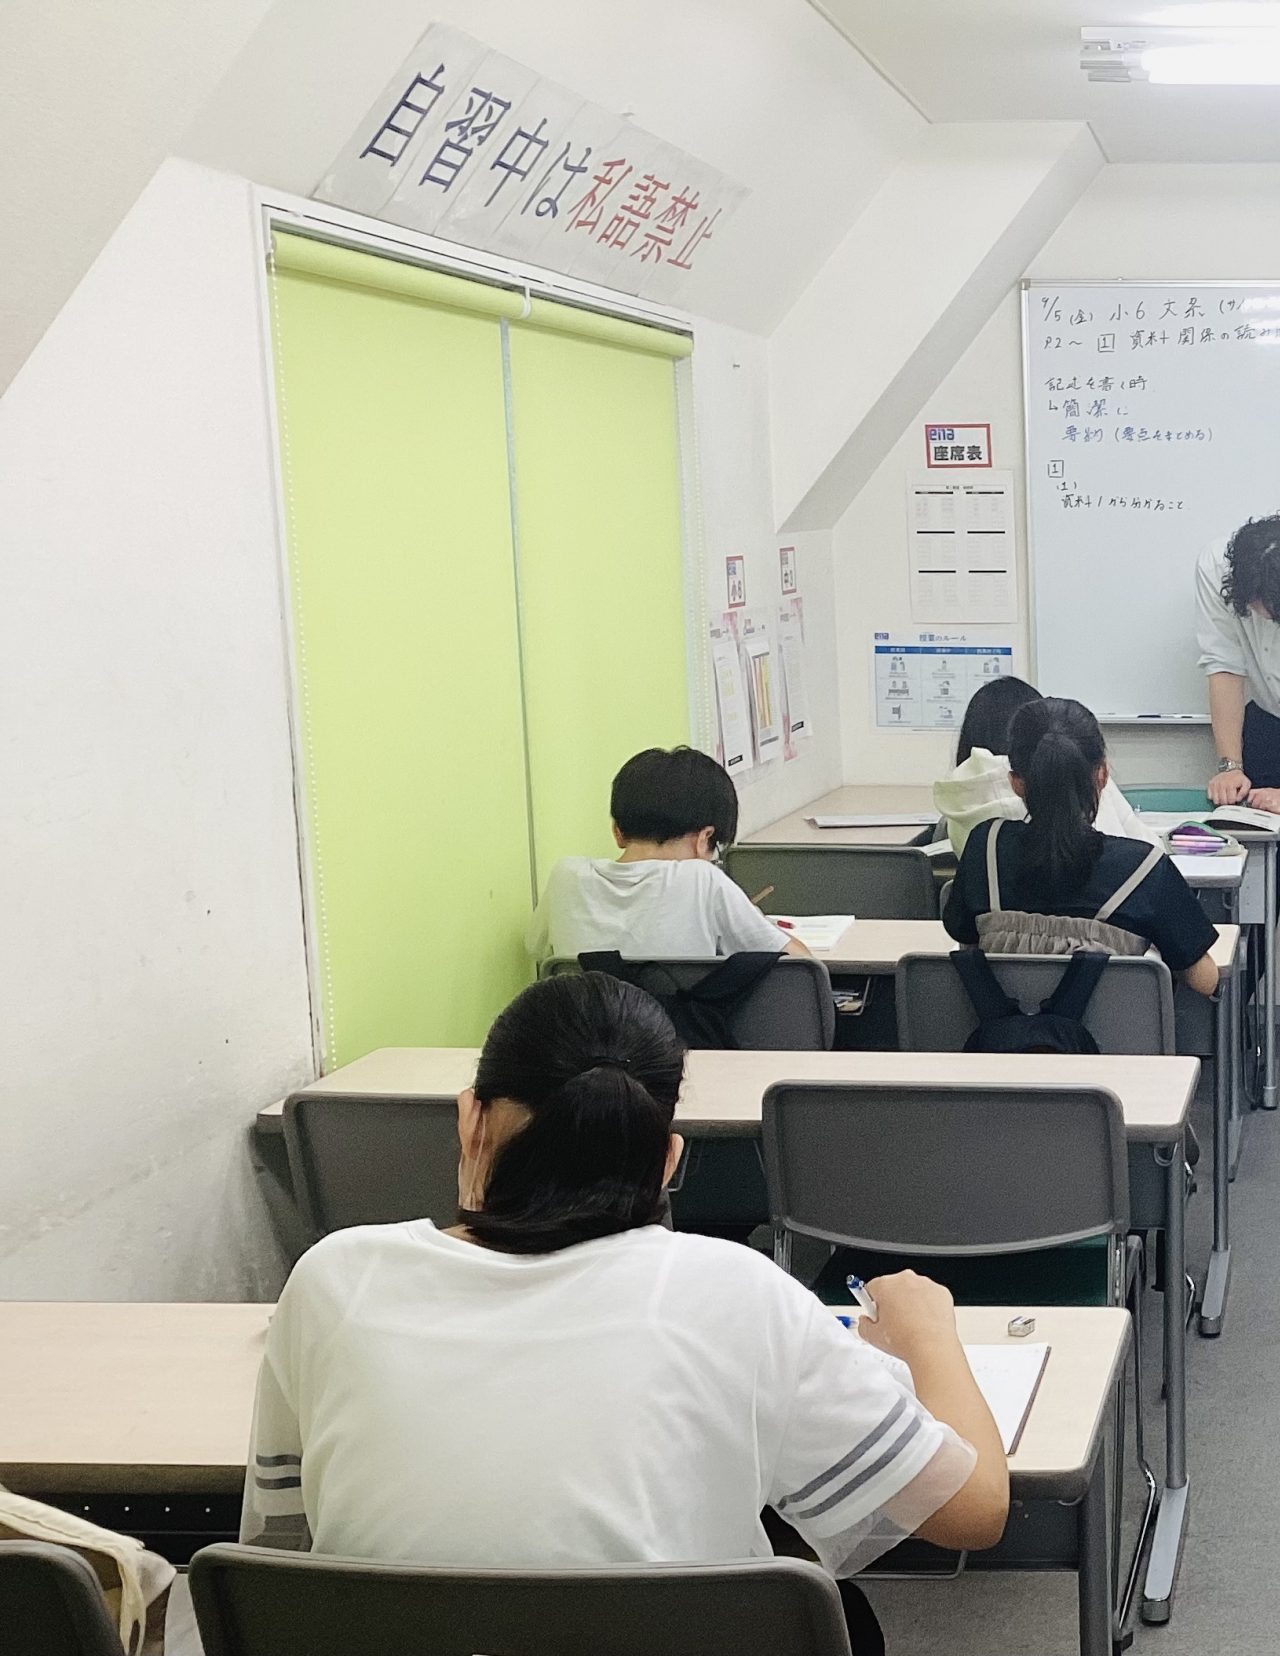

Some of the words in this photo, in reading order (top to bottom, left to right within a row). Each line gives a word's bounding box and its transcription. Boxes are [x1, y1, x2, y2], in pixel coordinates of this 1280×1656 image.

[360, 63, 723, 270] 自習中は私語禁止
[1109, 301, 1145, 320] 小6
[929, 428, 955, 441] ena
[934, 446, 983, 461] 座席表
